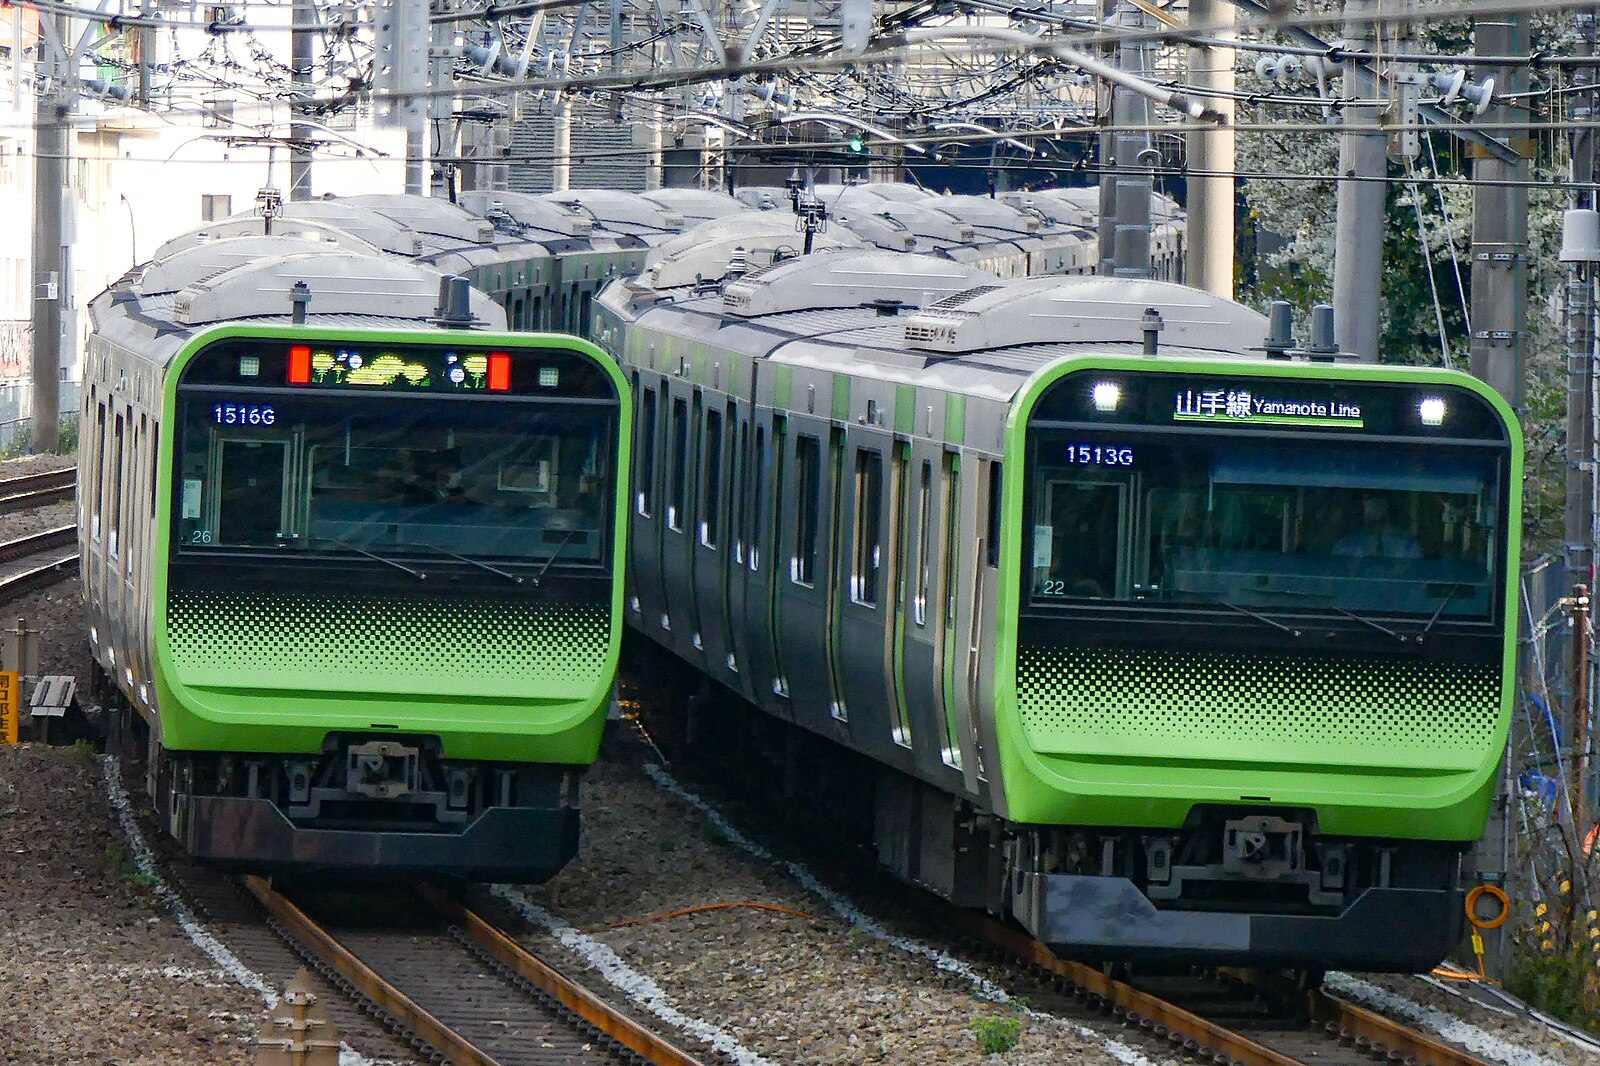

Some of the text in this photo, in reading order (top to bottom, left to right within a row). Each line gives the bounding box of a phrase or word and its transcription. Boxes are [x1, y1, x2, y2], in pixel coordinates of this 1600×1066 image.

[1176, 389, 1361, 418] 山手線 Yamanote Line
[215, 406, 275, 425] 1516G
[1067, 445, 1134, 466] 1513G
[192, 530, 212, 544] 26
[1043, 580, 1065, 595] 22
